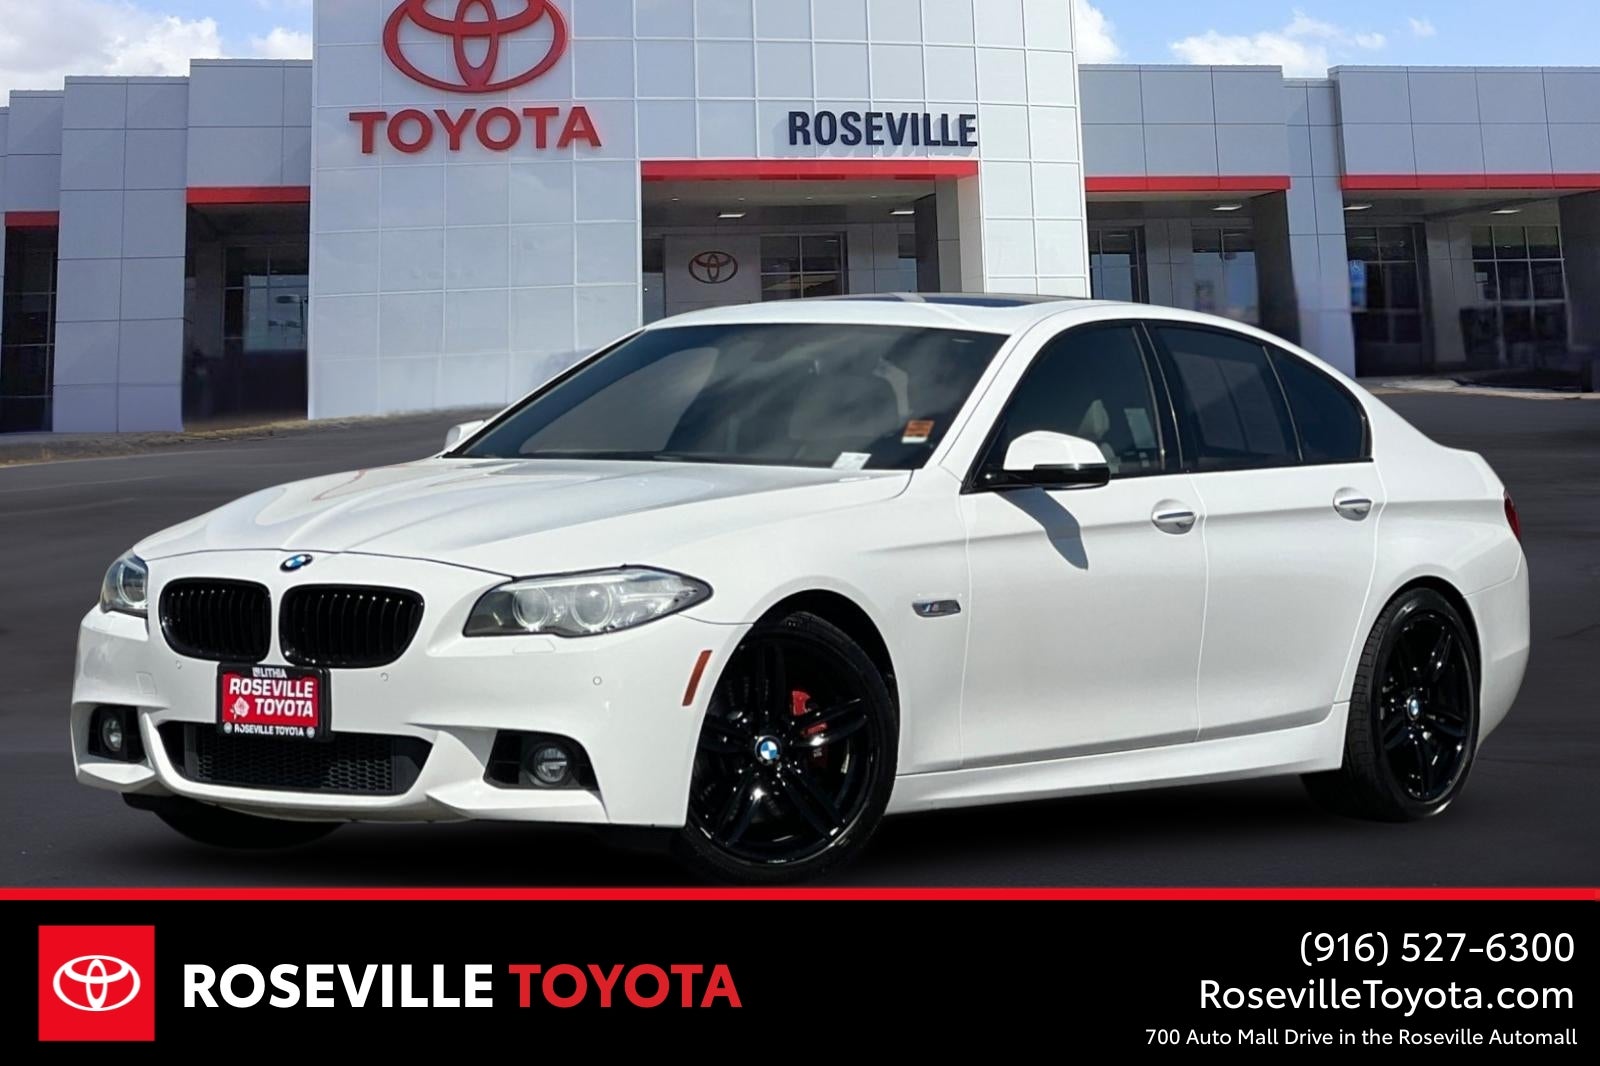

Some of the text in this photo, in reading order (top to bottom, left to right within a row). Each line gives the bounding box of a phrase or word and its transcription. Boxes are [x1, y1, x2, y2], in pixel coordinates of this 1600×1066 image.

[349, 105, 601, 154] TOYOTA
[788, 111, 978, 148] ROSEVILLE
[261, 667, 288, 679] LITHIA
[229, 677, 314, 698] ROSEVILLE
[255, 697, 314, 718] TOYOTA
[234, 723, 304, 736] ROSEVILLE TOYOTA
